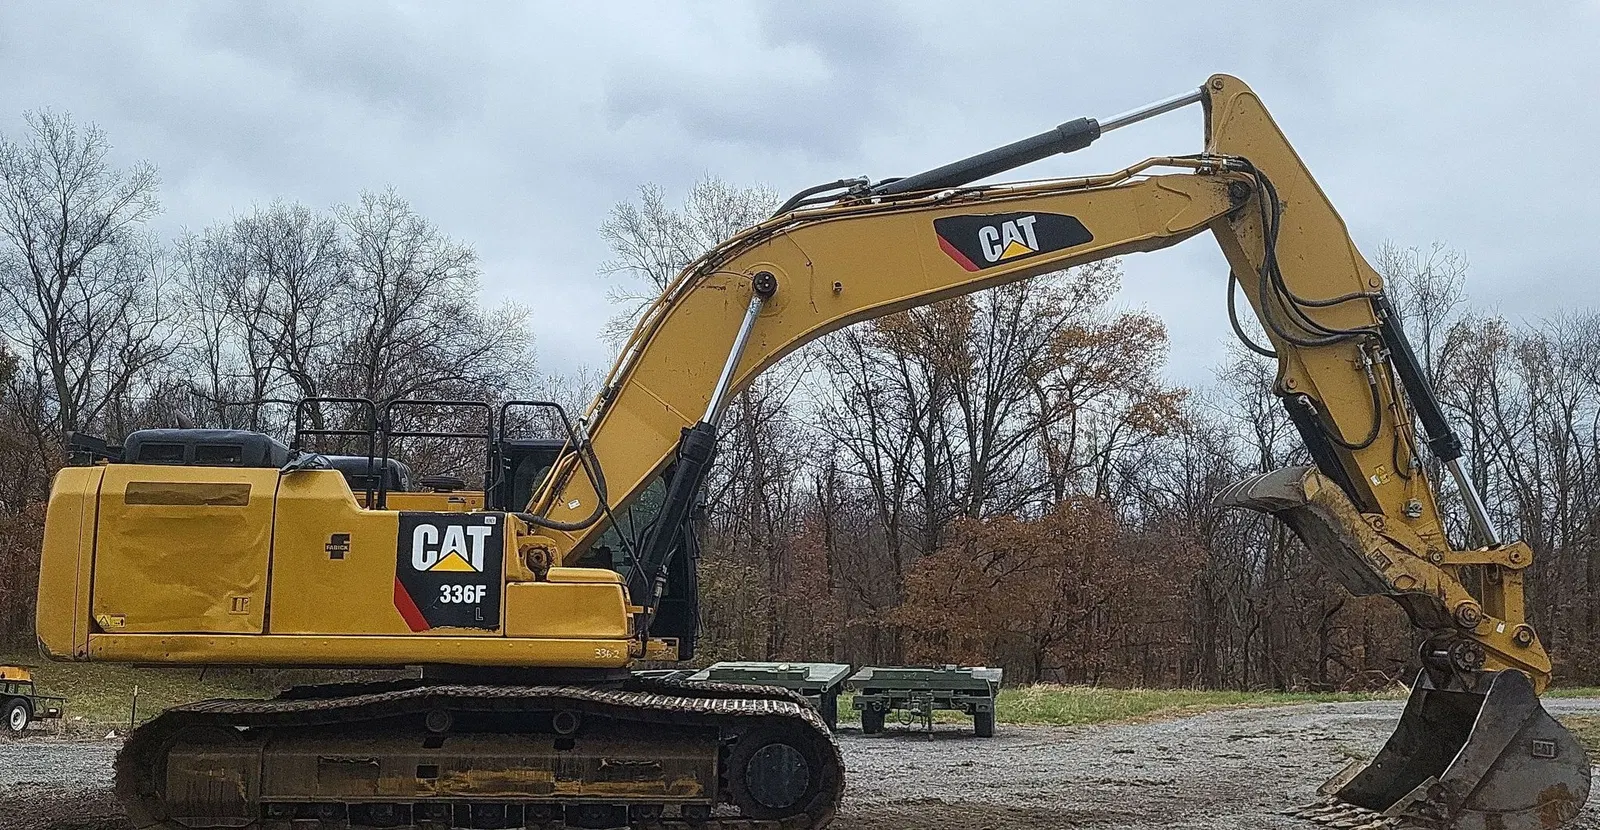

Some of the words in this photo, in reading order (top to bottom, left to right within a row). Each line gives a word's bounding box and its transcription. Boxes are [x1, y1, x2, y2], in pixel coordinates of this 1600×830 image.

[978, 215, 1040, 262] CAT
[411, 523, 492, 572] CAT
[439, 584, 487, 604] 336F
[475, 606, 484, 621] L
